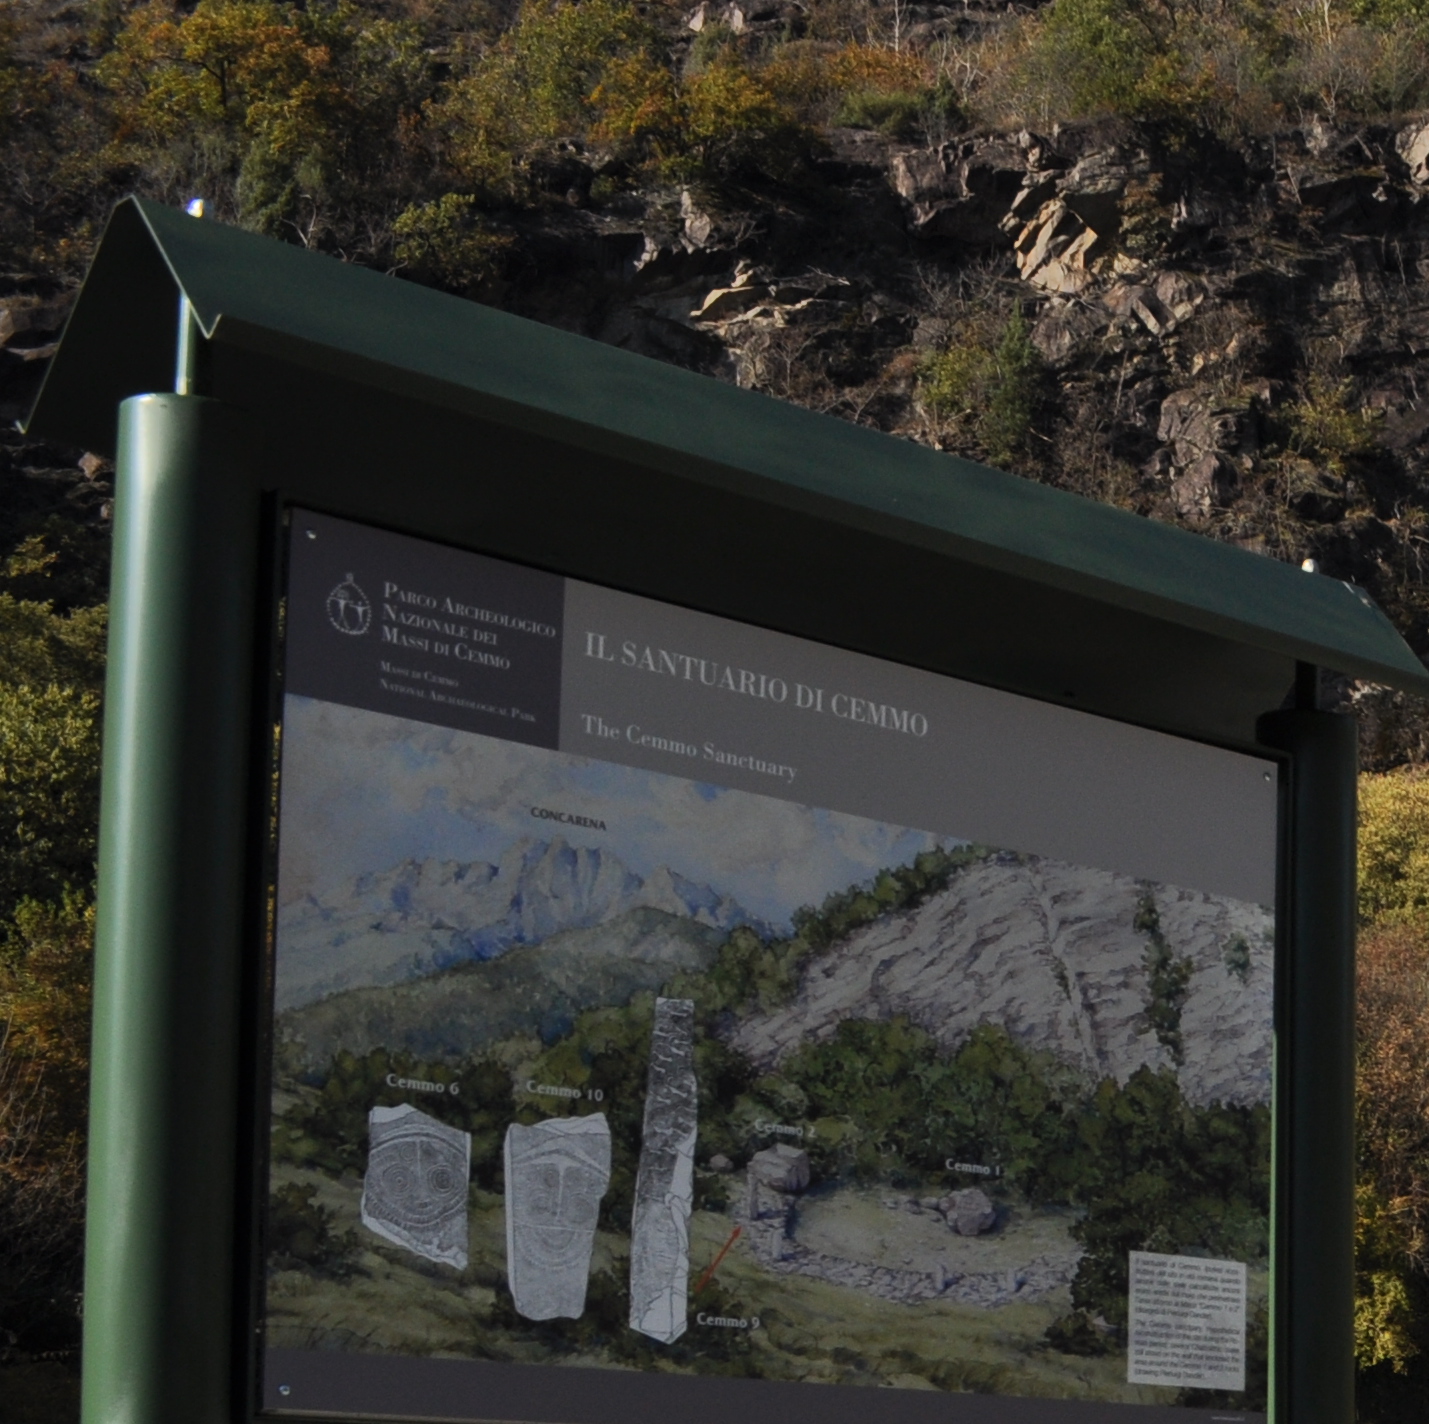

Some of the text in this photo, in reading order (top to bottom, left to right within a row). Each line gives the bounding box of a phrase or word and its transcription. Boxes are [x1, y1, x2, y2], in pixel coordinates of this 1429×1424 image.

[584, 632, 929, 738] IL SANTUARIO DI CEMMO
[582, 714, 799, 783] The Cemmo Sanctuary
[531, 807, 606, 831] CONCARENA
[386, 1073, 460, 1095] Cemmo 6
[526, 1080, 604, 1102] Cemmo 10
[754, 1119, 816, 1138] Cemmo 2
[945, 1158, 992, 1175] Cemmo
[696, 1312, 760, 1330] Cemmo 9
